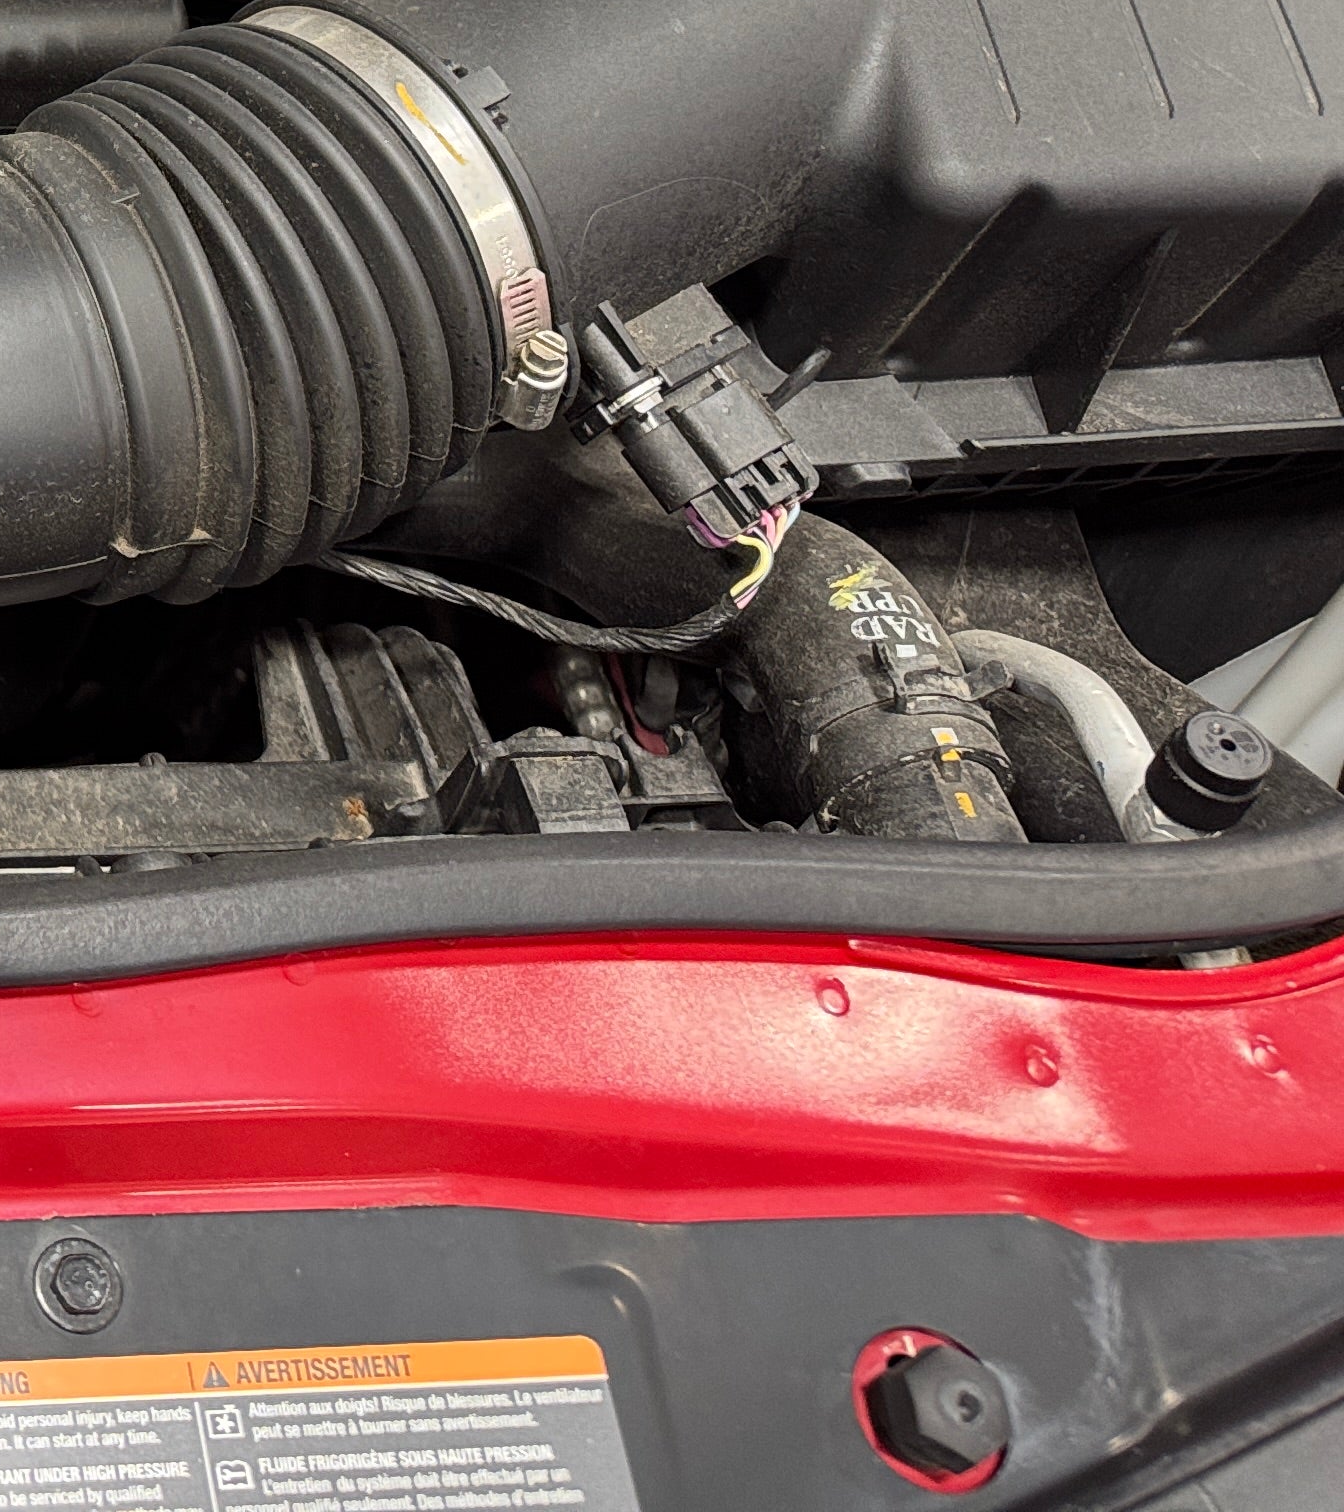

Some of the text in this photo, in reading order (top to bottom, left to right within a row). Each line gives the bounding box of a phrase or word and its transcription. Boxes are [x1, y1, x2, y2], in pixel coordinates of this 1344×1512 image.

[850, 614, 942, 648] RAD
[236, 1354, 411, 1384] AVERTISSEMENT
[248, 1387, 604, 1418] Attention aux doigts! Risque de blessures. Le ventilateur
[18, 1411, 73, 1430] personal
[74, 1409, 115, 1429] injury,
[116, 1407, 149, 1425] keep
[151, 1405, 191, 1422] hands
[252, 1411, 540, 1442] peut se mettre à tourner sans avertissement.
[25, 1436, 51, 1449] can
[52, 1431, 84, 1448] start
[84, 1431, 100, 1446] at
[101, 1432, 128, 1448] any
[128, 1429, 162, 1444] time.
[33, 1465, 81, 1484] UNDER
[82, 1463, 117, 1482] HIGH
[118, 1461, 191, 1480] PRESSURE
[259, 1455, 308, 1475] FLUIDE
[307, 1449, 398, 1473] FRIGORIGÈNE
[398, 1450, 438, 1468] SOUS
[437, 1447, 485, 1466] HAUTE
[10, 1488, 27, 1506] be
[29, 1487, 85, 1505] serviced
[85, 1486, 105, 1505] by
[105, 1484, 162, 1504] qualified
[262, 1478, 332, 1496] L'entretien
[335, 1475, 356, 1493] du
[356, 1473, 412, 1494] système
